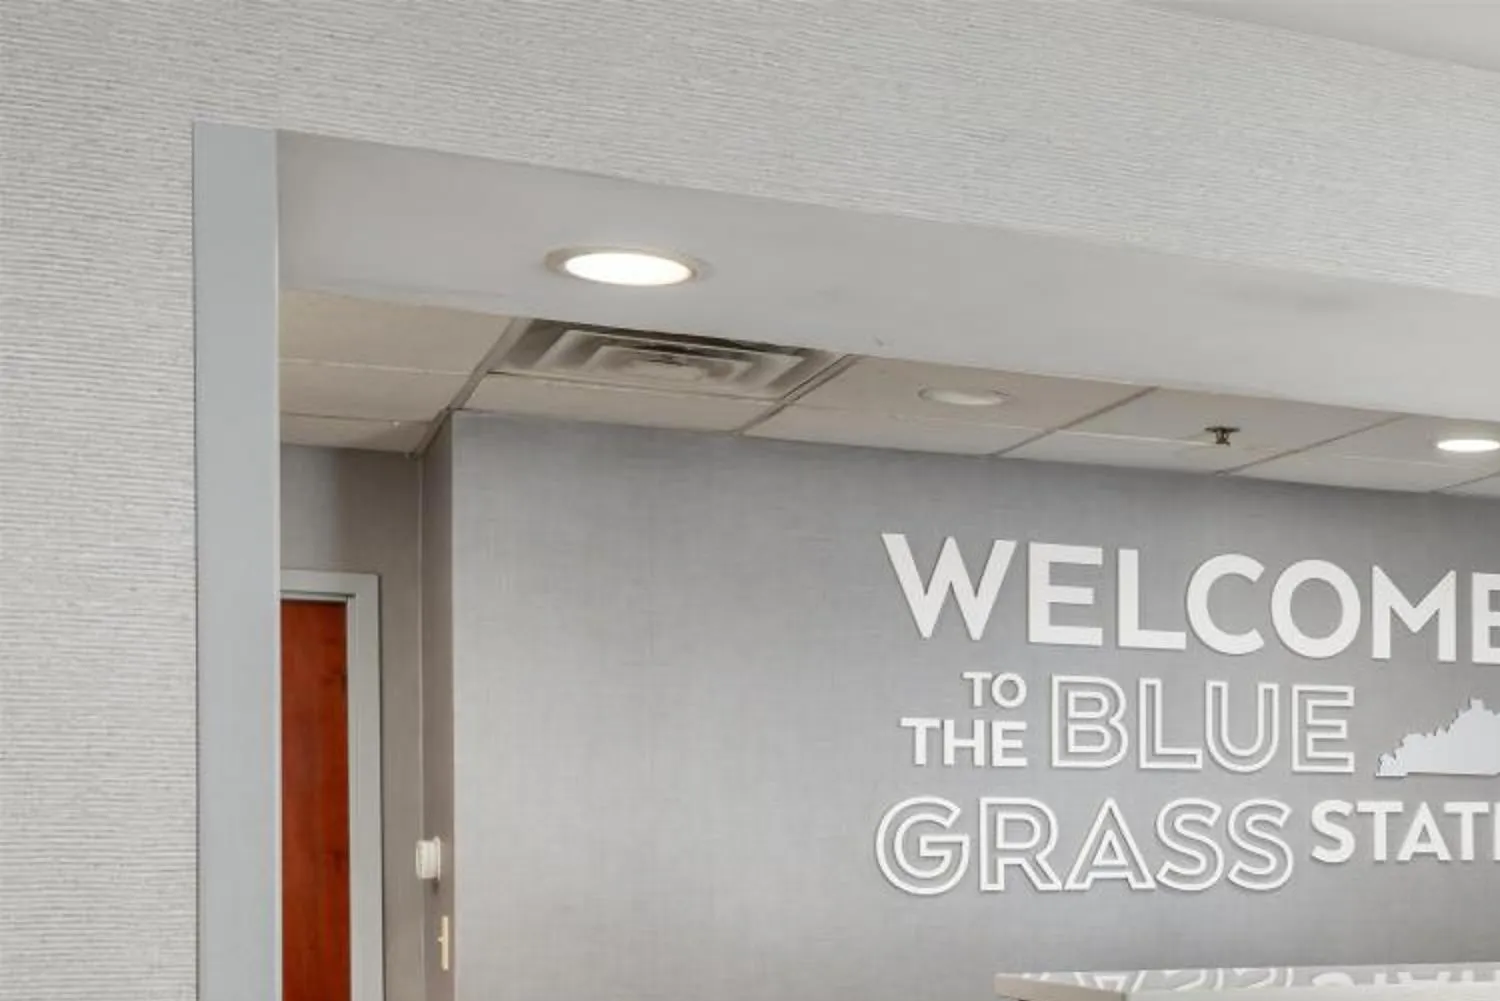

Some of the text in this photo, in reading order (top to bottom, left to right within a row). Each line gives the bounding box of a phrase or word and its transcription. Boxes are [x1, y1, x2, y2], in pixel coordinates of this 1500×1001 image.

[901, 674, 1355, 773] THE BLUE
[962, 671, 1027, 707] TO
[875, 797, 1295, 895] GRASS
